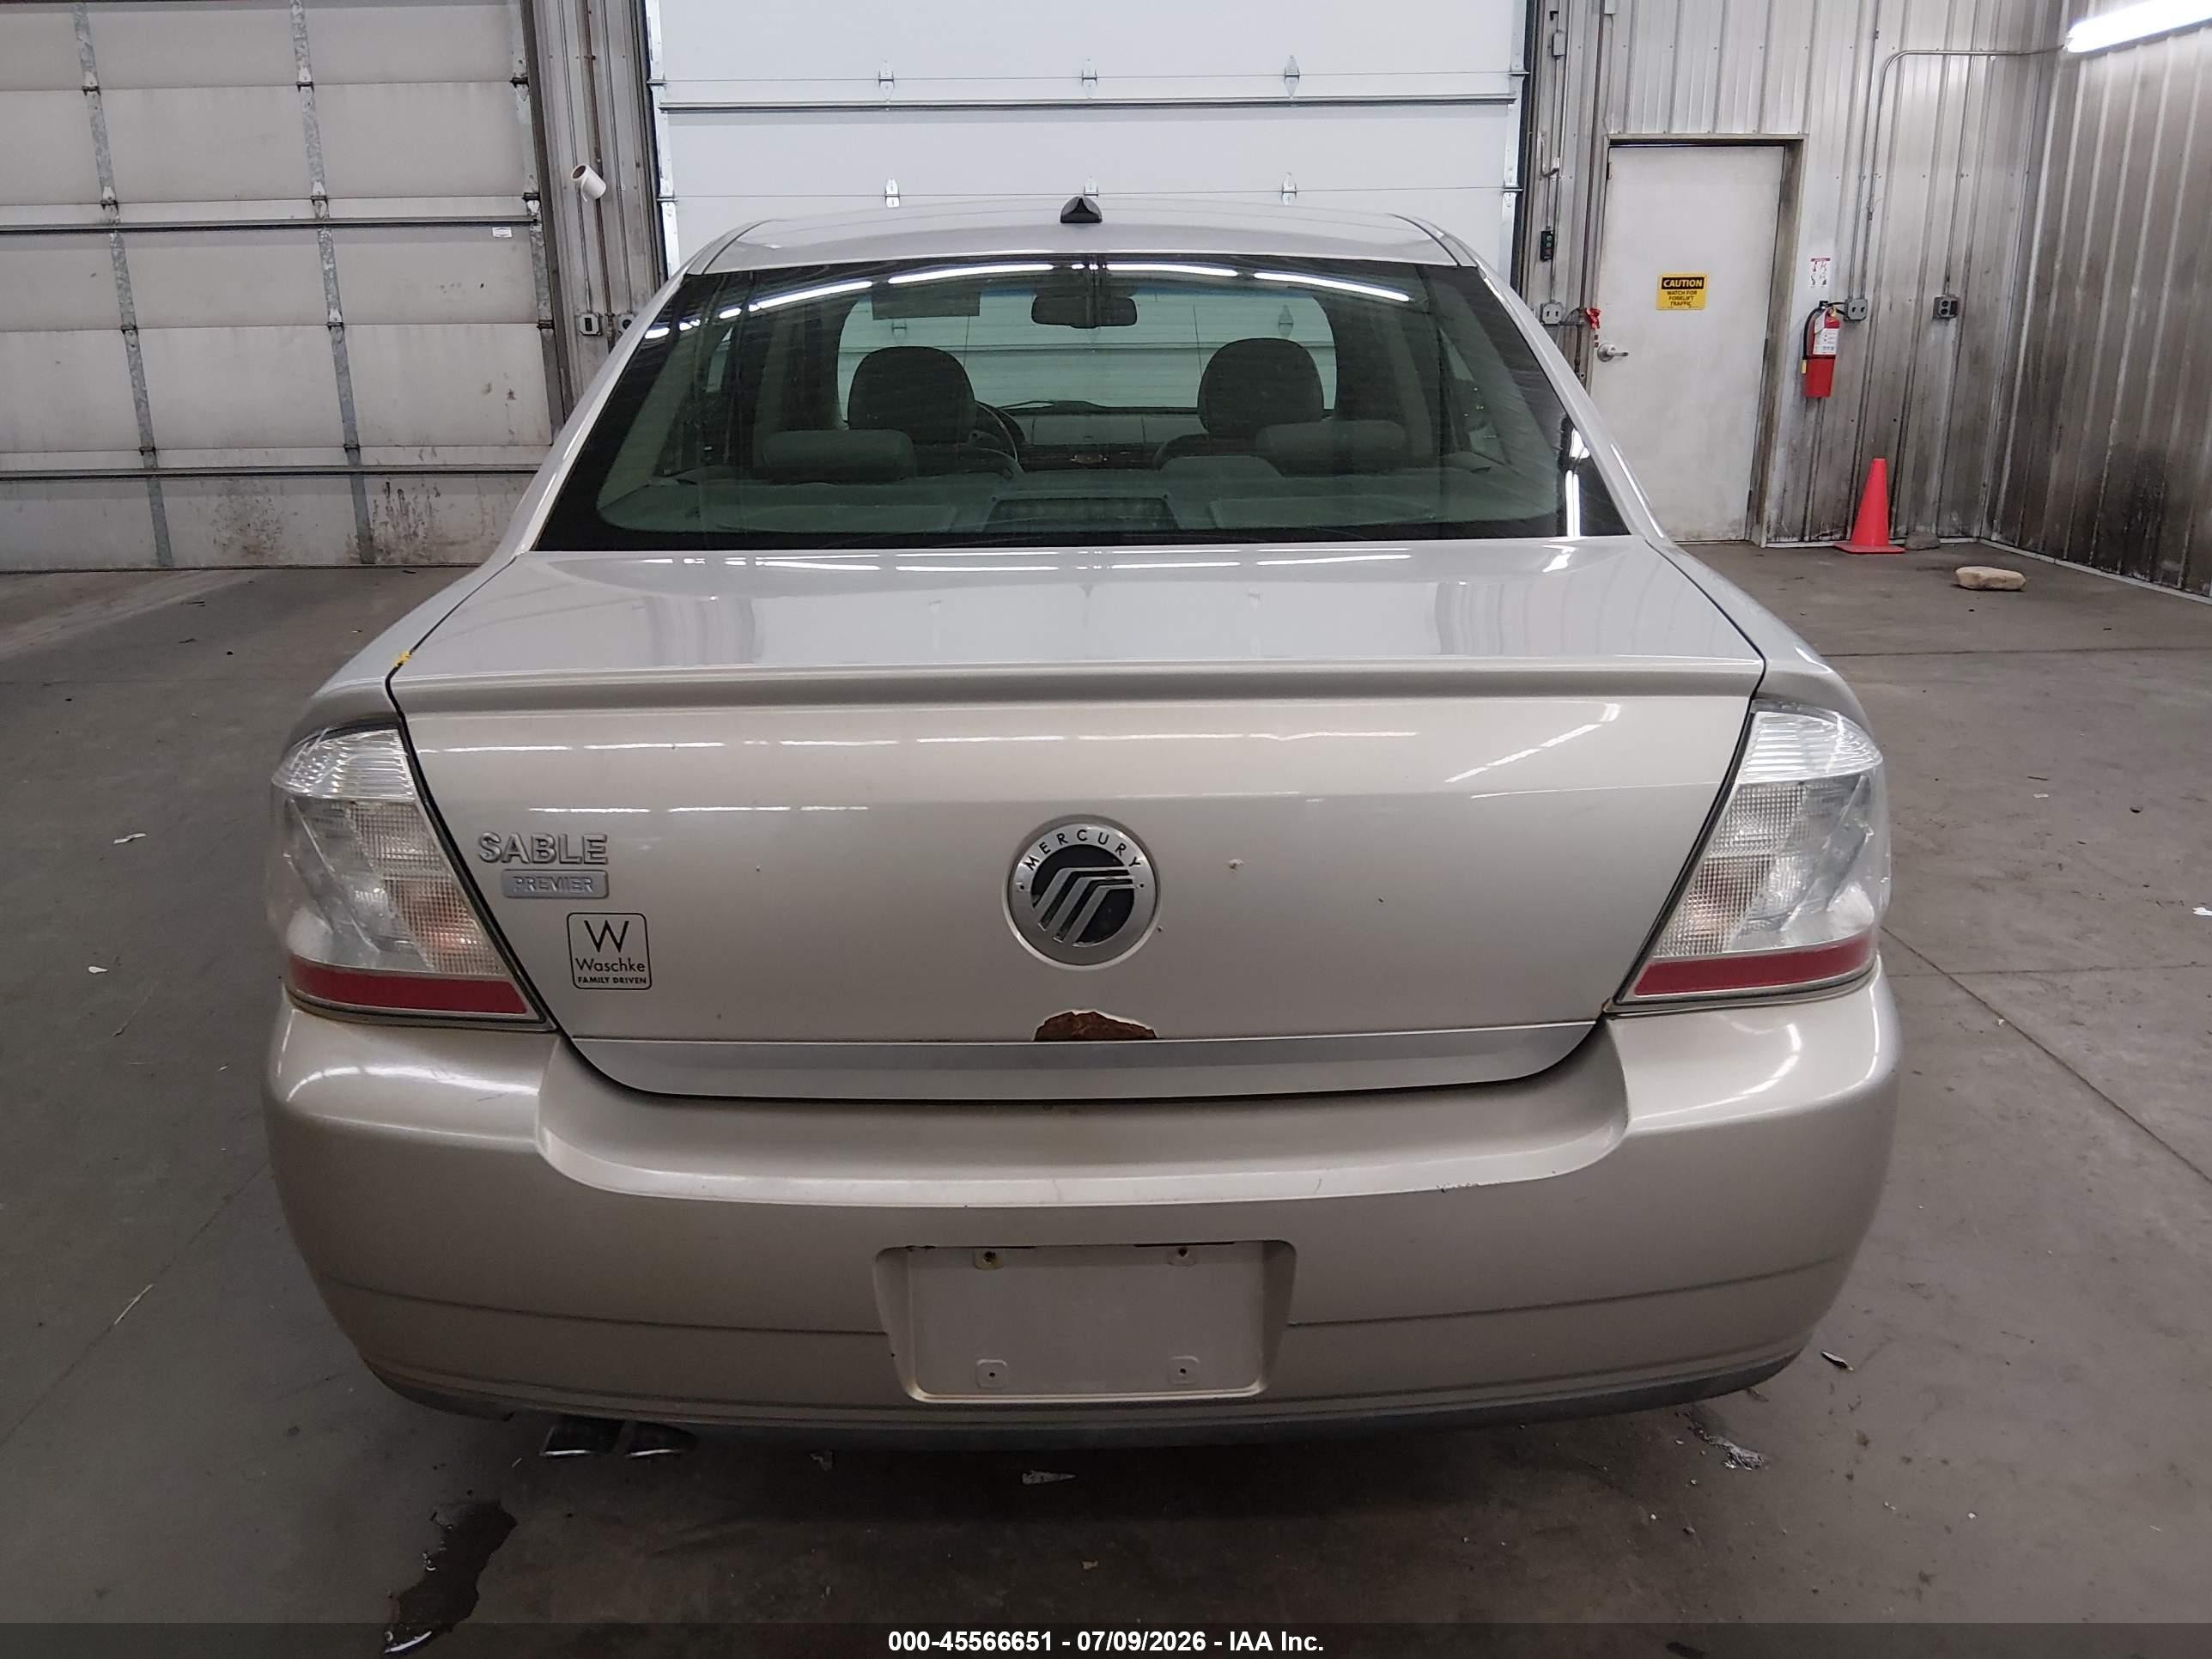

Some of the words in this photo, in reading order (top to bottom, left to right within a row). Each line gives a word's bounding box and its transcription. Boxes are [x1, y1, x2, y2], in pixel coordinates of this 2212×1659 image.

[1663, 279, 1703, 288] CAUTION
[478, 831, 609, 865] SABLE
[1023, 830, 1141, 871] MERCURY
[513, 876, 593, 893] PREMIER
[584, 920, 629, 953] W
[575, 957, 646, 973] Waschke
